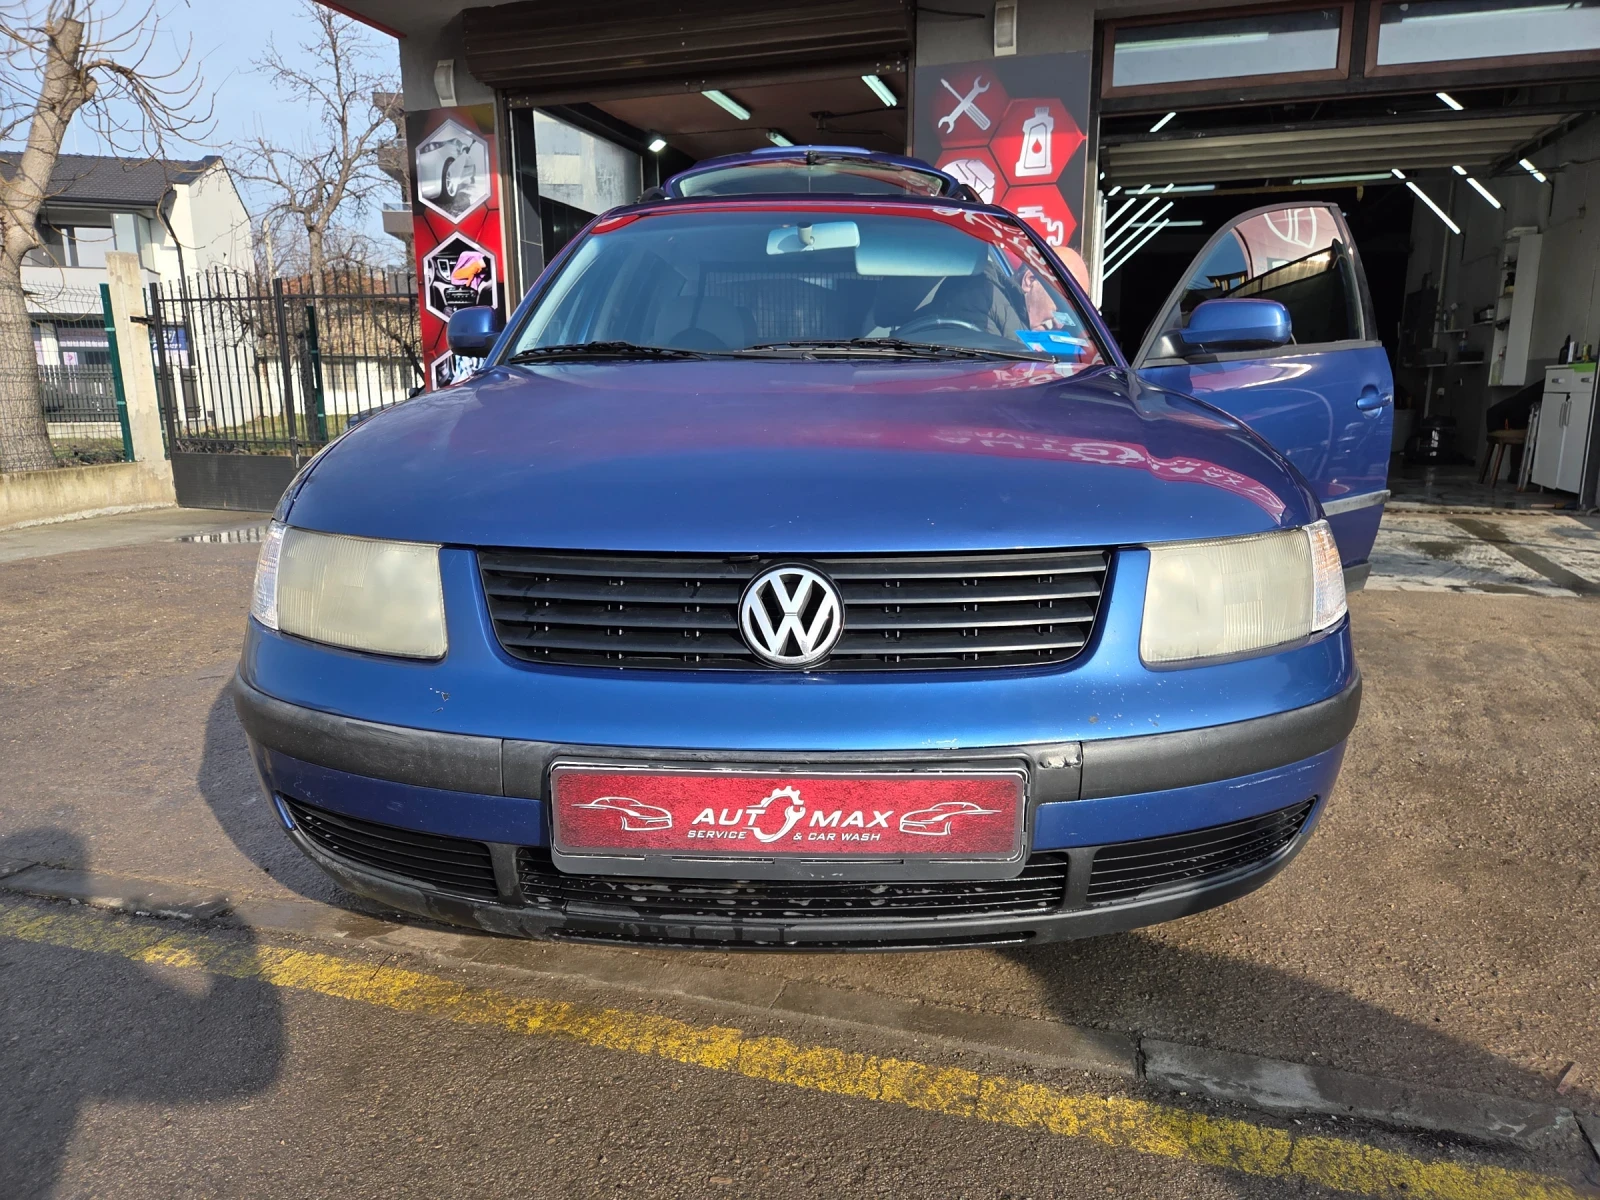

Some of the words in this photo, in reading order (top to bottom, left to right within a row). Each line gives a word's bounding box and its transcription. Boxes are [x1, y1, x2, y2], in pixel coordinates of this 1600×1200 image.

[687, 829, 747, 839] SERVICE
[792, 832, 803, 841] &
[807, 832, 838, 841] CAR
[841, 832, 881, 842] WASH
